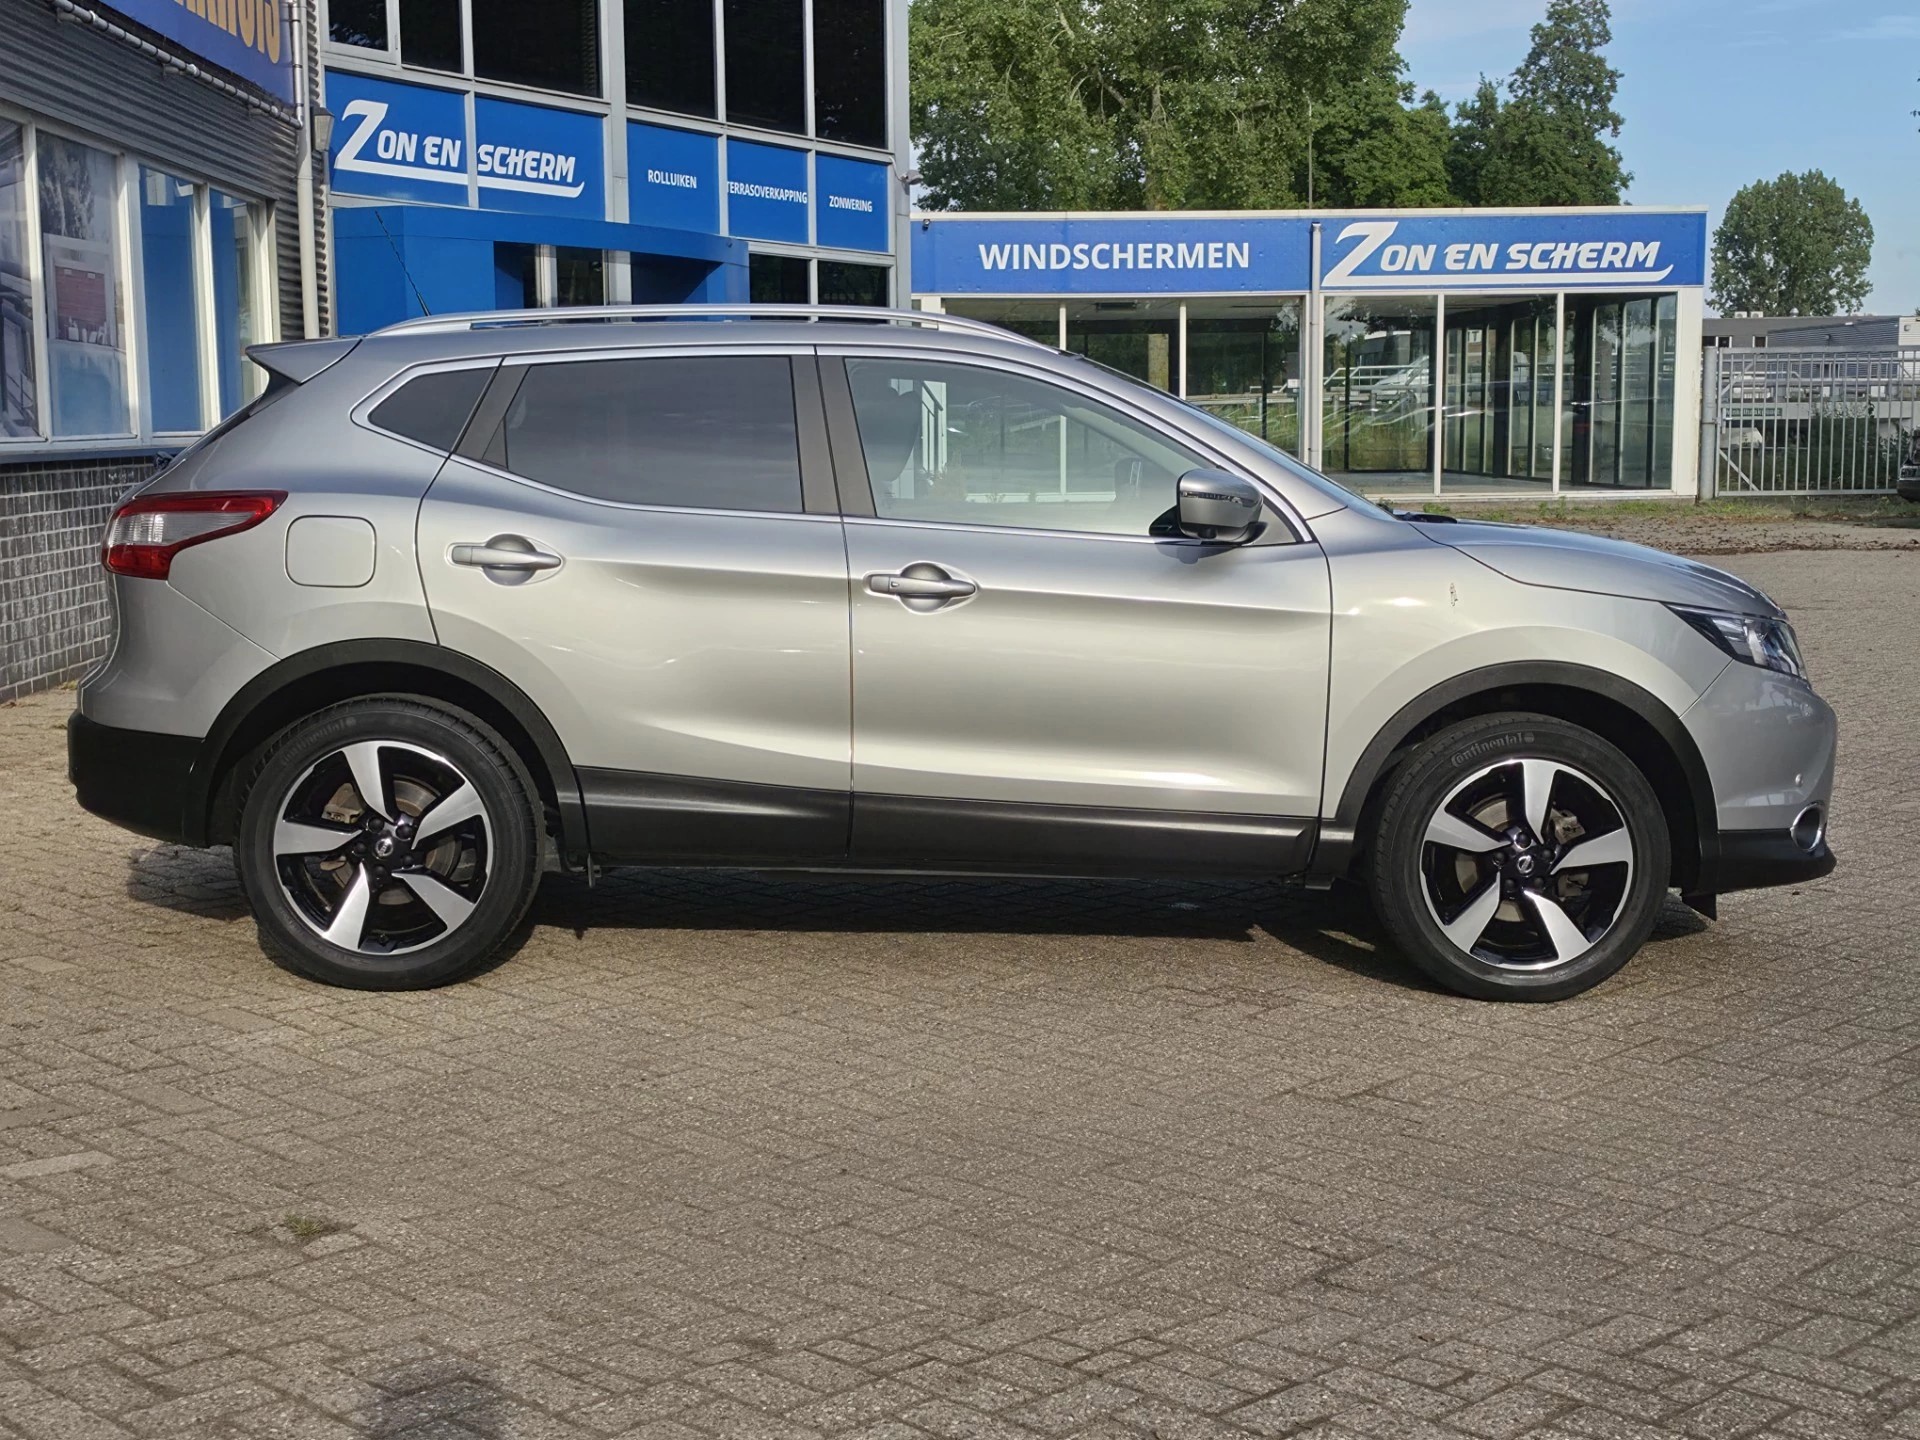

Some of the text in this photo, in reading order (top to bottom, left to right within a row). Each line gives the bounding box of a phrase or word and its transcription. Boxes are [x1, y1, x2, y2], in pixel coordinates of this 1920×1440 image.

[334, 99, 576, 183] ZON EN SCHERM
[648, 169, 697, 189] ROLLUIKEN
[829, 195, 873, 213] ZONWERING
[978, 242, 1249, 270] WINDSCHERMEN
[1321, 221, 1661, 287] ZON EN SCHERM
[1451, 732, 1523, 768] Continental
